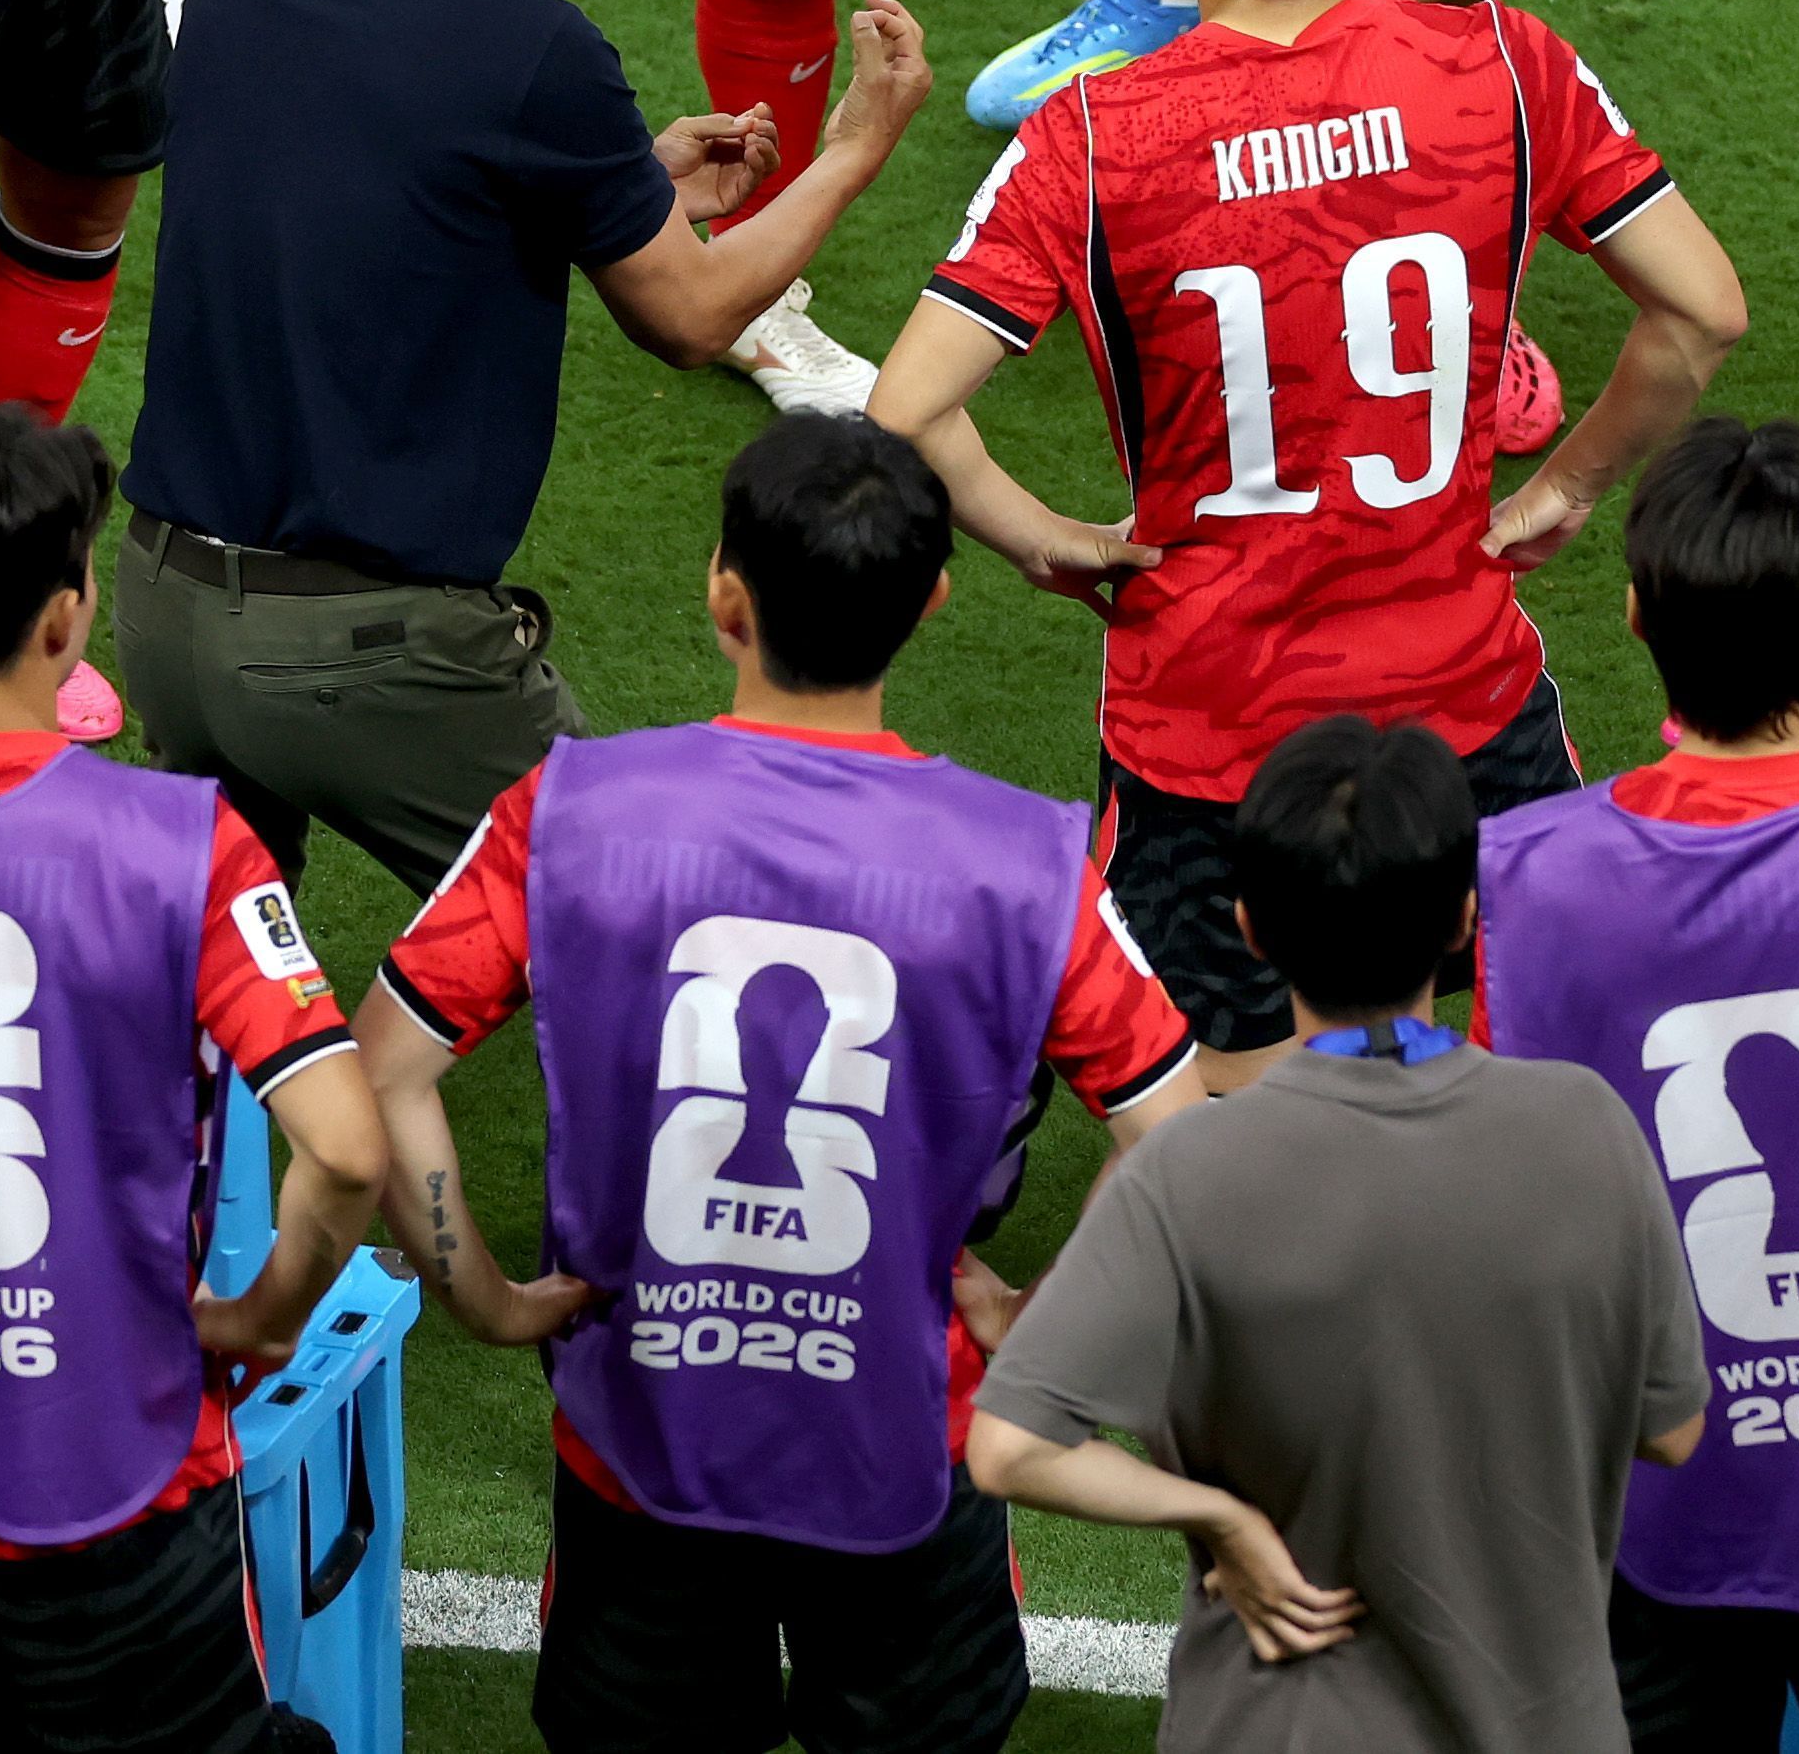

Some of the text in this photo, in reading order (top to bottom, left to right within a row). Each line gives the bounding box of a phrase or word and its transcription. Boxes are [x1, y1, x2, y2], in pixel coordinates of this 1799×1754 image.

[1211, 106, 1410, 203] KANGIN
[1173, 231, 1474, 522] 19
[704, 1198, 808, 1242] FIFA
[635, 1279, 863, 1327] WORLD CUP
[630, 1316, 856, 1382] 2026
